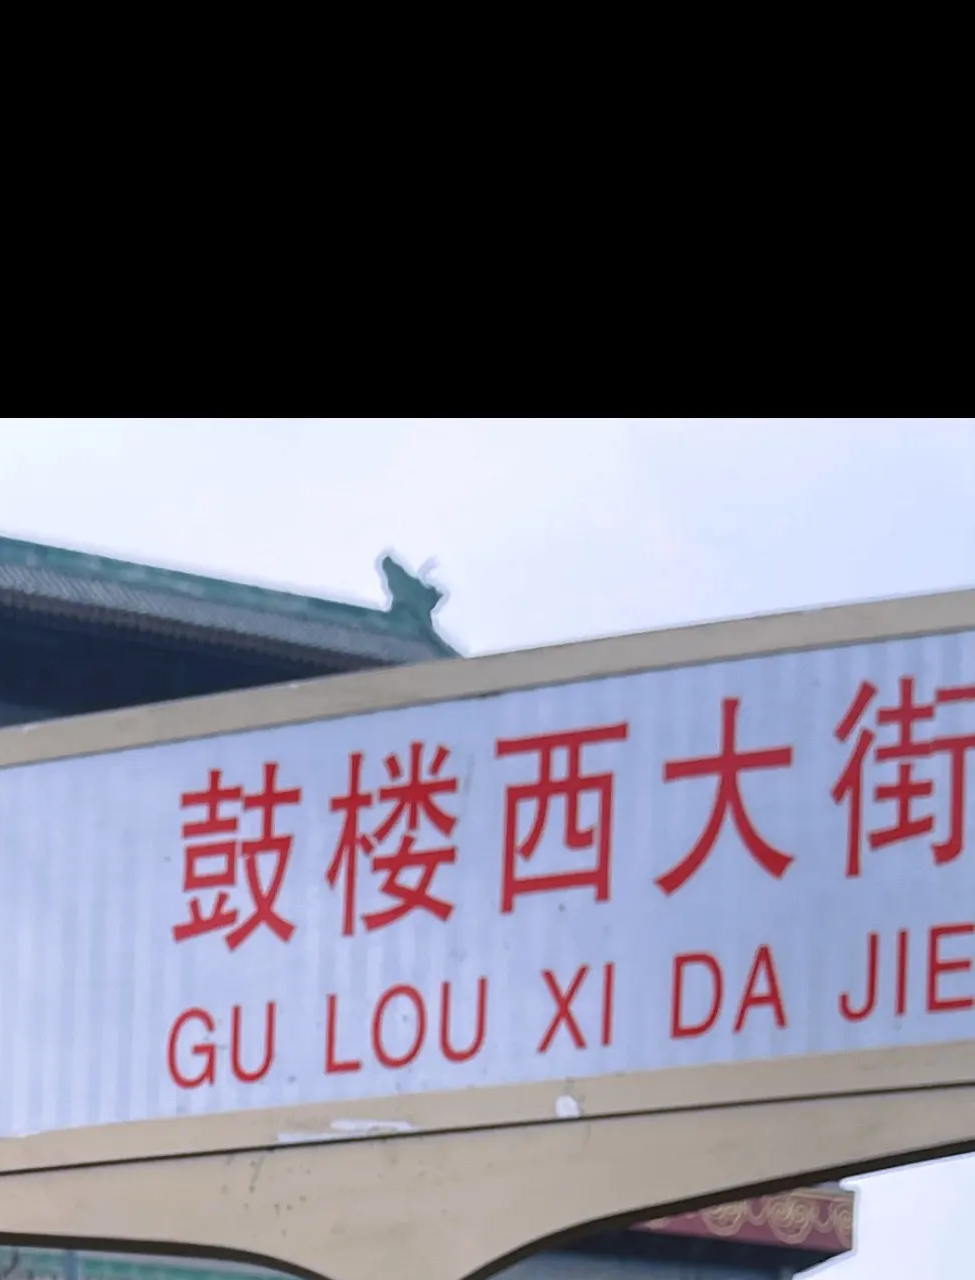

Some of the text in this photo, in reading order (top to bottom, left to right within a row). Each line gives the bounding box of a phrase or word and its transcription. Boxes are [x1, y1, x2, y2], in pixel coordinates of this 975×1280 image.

[174, 679, 975, 950] 鼓楼西大街
[167, 924, 975, 1089] GU LOU XI DA JIE
